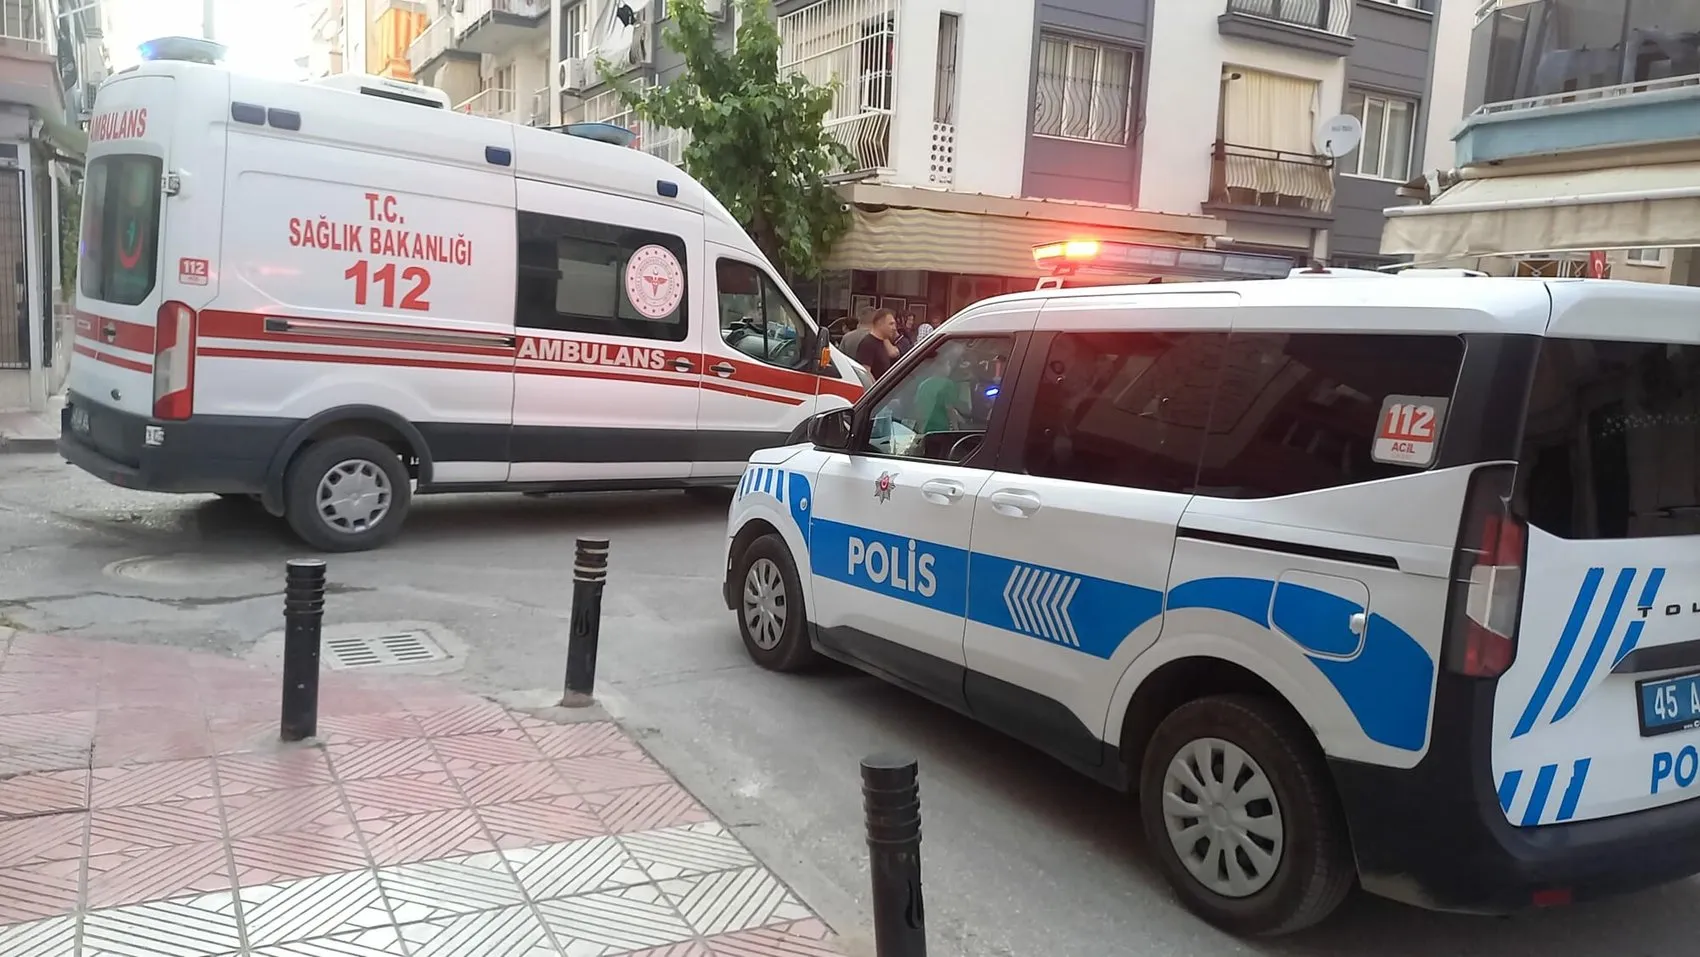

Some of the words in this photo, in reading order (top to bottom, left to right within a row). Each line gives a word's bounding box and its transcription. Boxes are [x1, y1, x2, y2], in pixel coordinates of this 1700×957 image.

[365, 193, 404, 224] T.C.
[289, 214, 362, 253] SAĞLIK
[370, 228, 472, 266] BAKANLIĞI
[183, 260, 205, 275] 112
[345, 260, 431, 311] 112
[518, 337, 665, 370] AMBULANS
[1388, 403, 1434, 437] 112
[848, 536, 937, 597] POLİS
[1654, 685, 1678, 720] 45
[1651, 745, 1699, 794] PO
